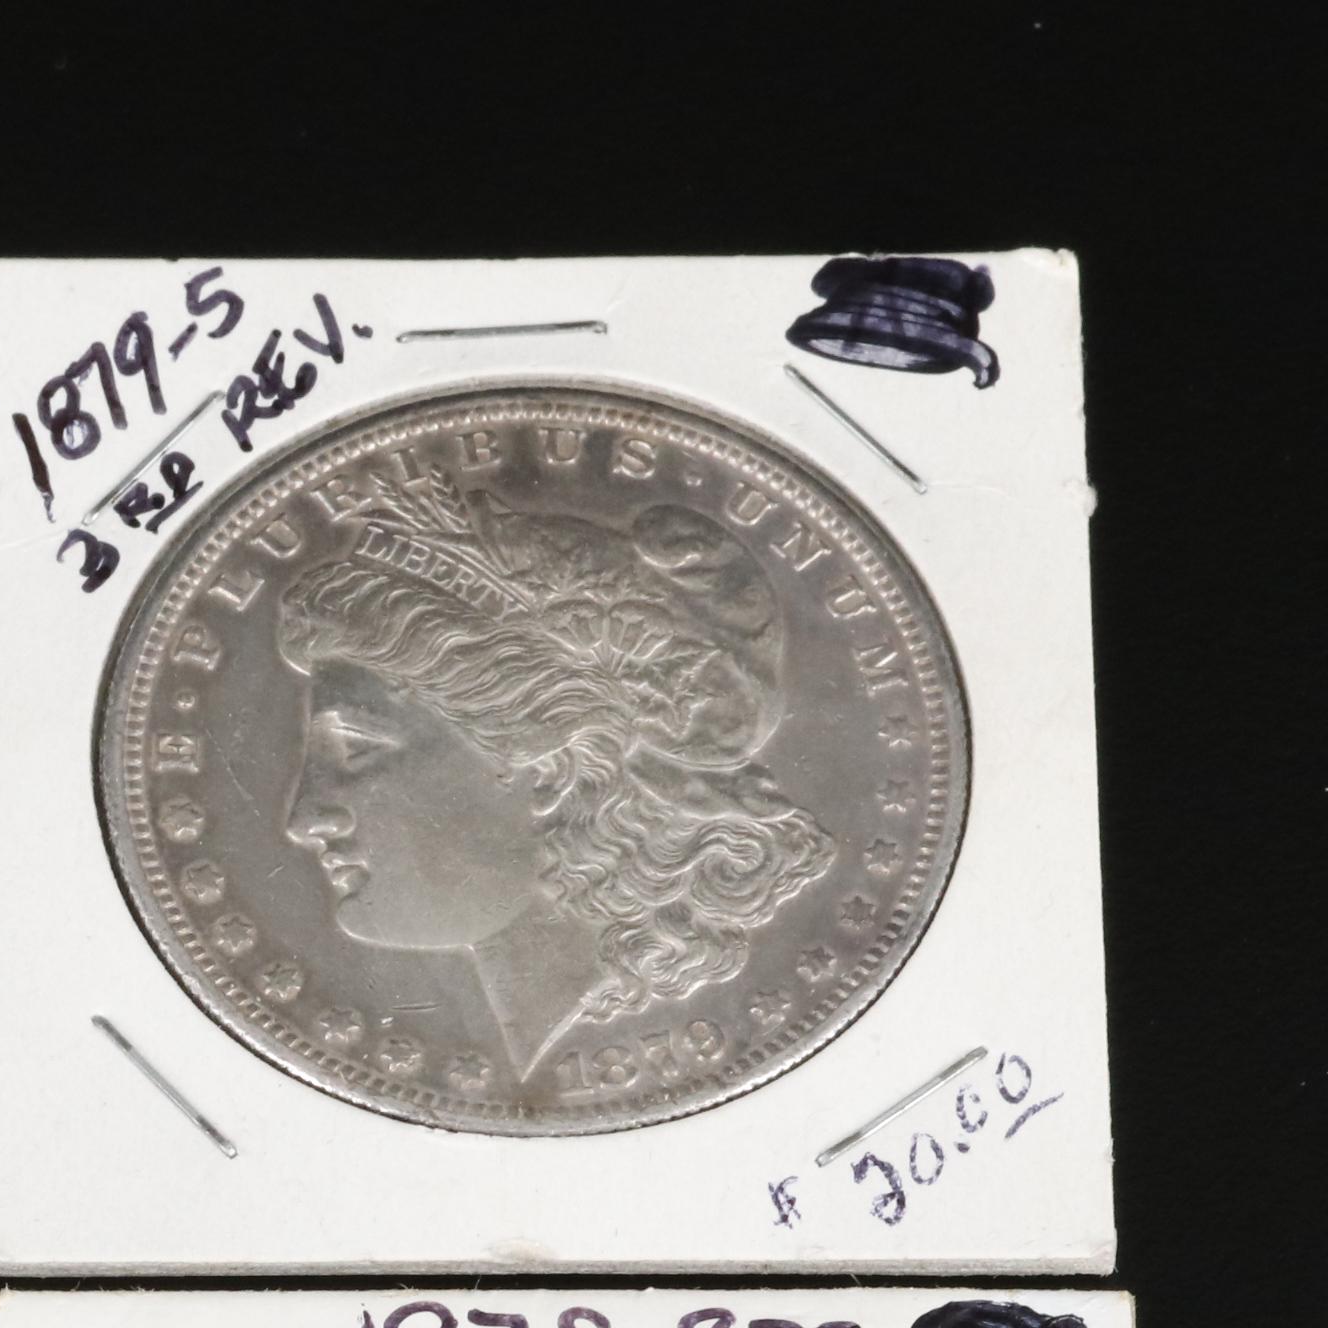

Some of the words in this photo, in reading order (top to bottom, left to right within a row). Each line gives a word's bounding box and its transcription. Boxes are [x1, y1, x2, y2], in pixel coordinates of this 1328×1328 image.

[172, 426, 657, 672] PLURIBUS
[355, 526, 529, 624] LIBERTY
[725, 480, 910, 697] UNUM
[152, 732, 200, 773] E
[556, 1018, 726, 1097] 1879
